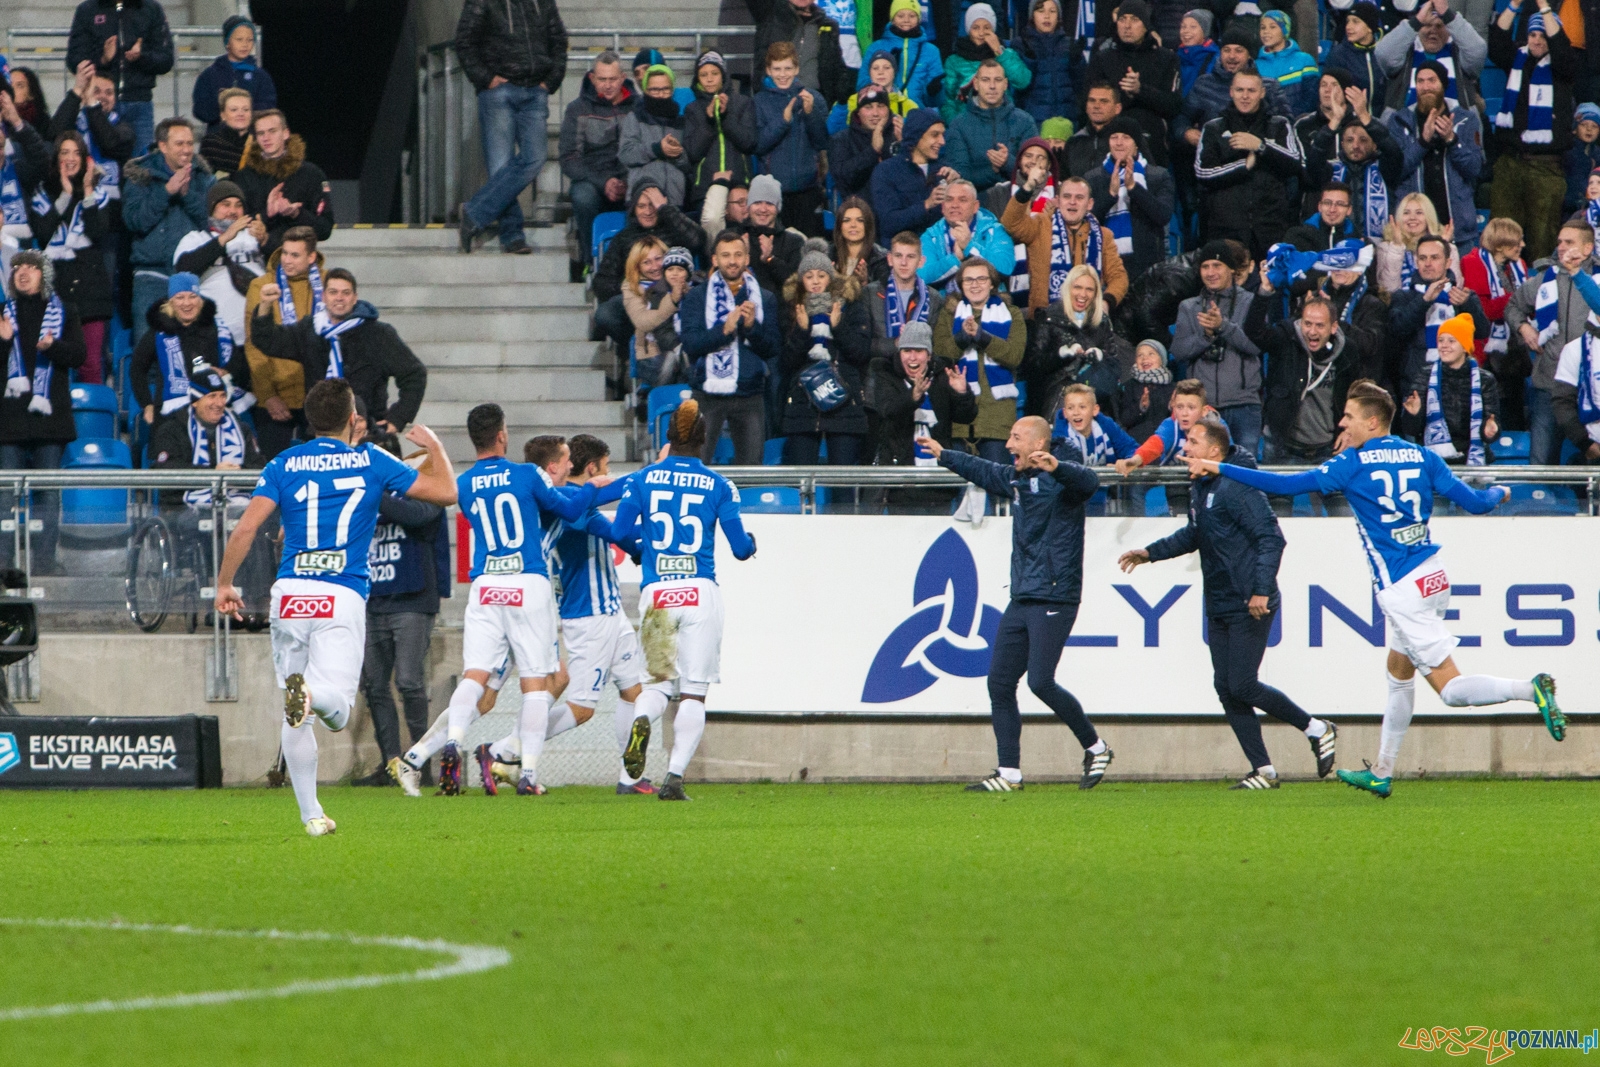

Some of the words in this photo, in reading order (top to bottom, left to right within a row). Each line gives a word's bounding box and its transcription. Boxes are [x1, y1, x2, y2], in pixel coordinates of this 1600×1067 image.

[812, 378, 839, 401] NIKE
[284, 450, 371, 473] MAKUSZEWSKI
[1358, 448, 1425, 464] BEDNAREK
[471, 468, 512, 493] JEVTIĆ
[645, 469, 672, 485] AZIZ
[672, 471, 716, 492] TETTEH
[1370, 468, 1423, 524] 35
[293, 475, 366, 550] 17
[470, 492, 525, 552] 10
[649, 490, 706, 554] 55
[1395, 525, 1427, 545] LECH
[301, 552, 341, 568] LECH
[488, 556, 520, 571] LECH
[660, 558, 693, 570] LECH
[370, 563, 396, 583] 020
[280, 596, 333, 618] Fogo
[480, 588, 522, 605] Fogo
[655, 588, 698, 608] Fogo
[1062, 583, 1600, 648] LYNES
[29, 735, 177, 753] EKSTRAKLASA
[101, 754, 177, 769] PARK
